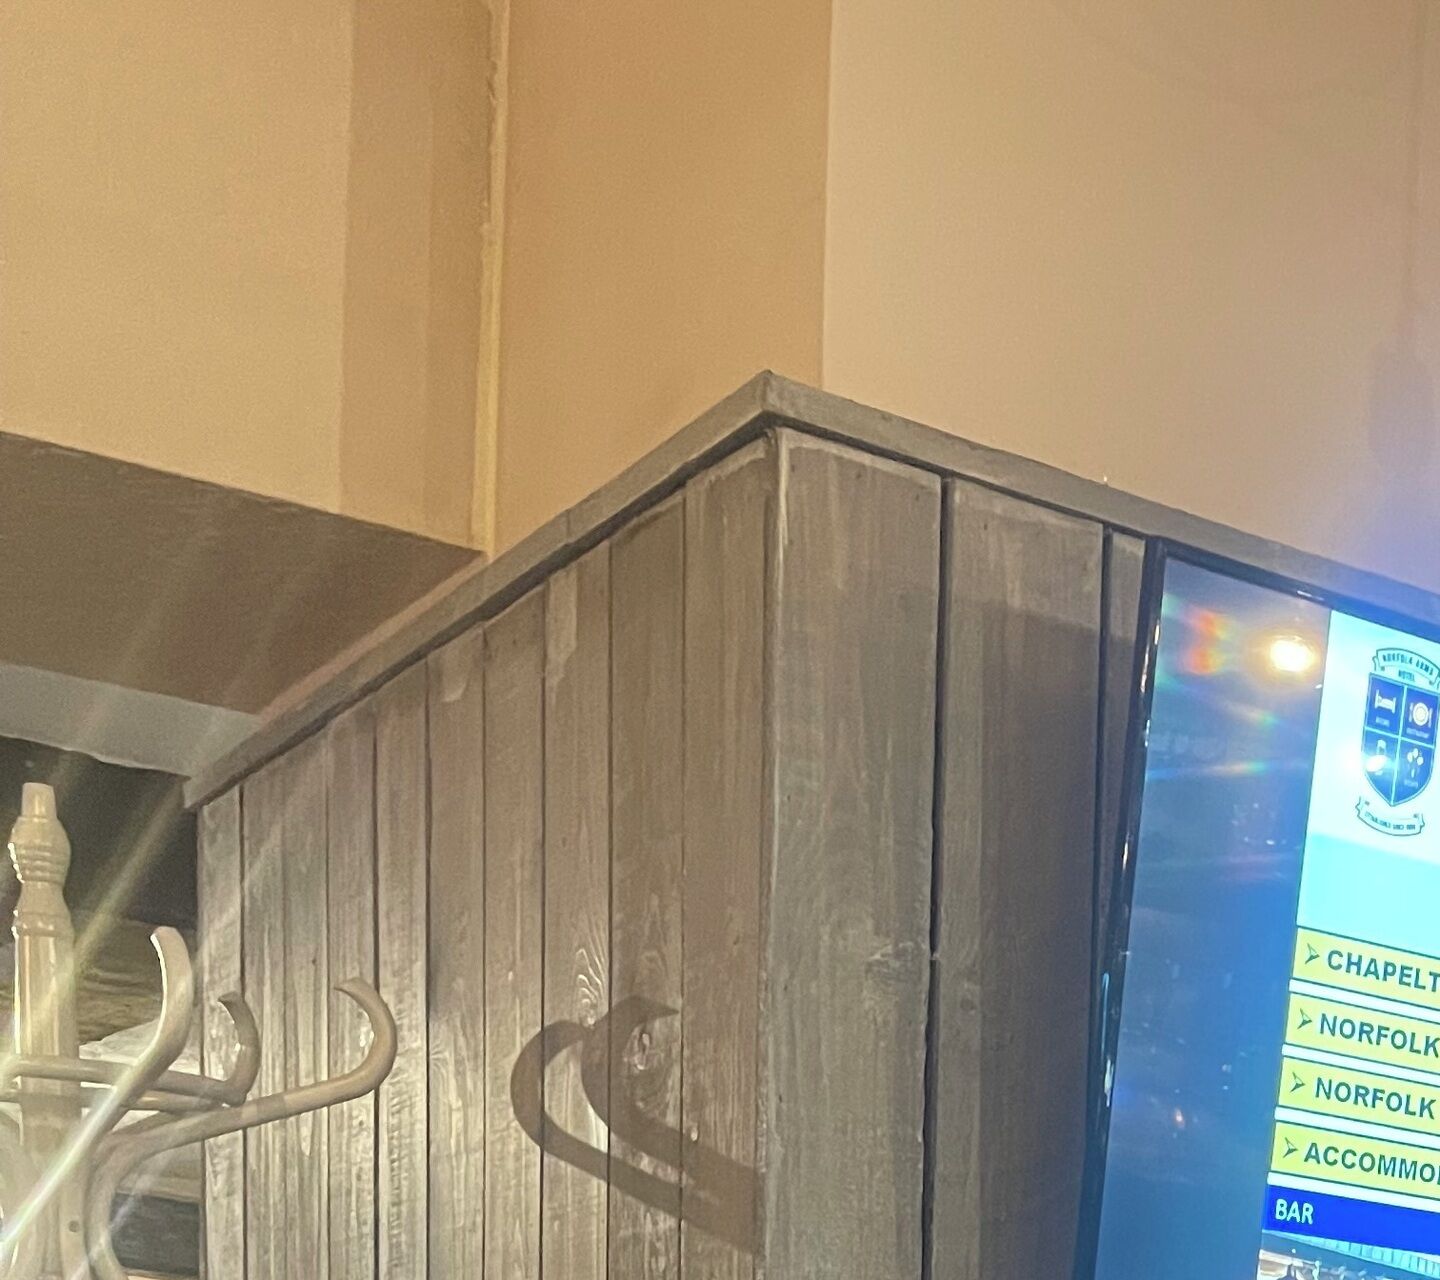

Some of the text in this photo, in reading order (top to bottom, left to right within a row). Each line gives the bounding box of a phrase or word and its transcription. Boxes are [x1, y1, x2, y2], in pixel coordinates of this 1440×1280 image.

[1319, 1013, 1440, 1058] NORFOLK
[1314, 1076, 1436, 1120] NORFOLK
[1274, 1198, 1314, 1225] BAR
